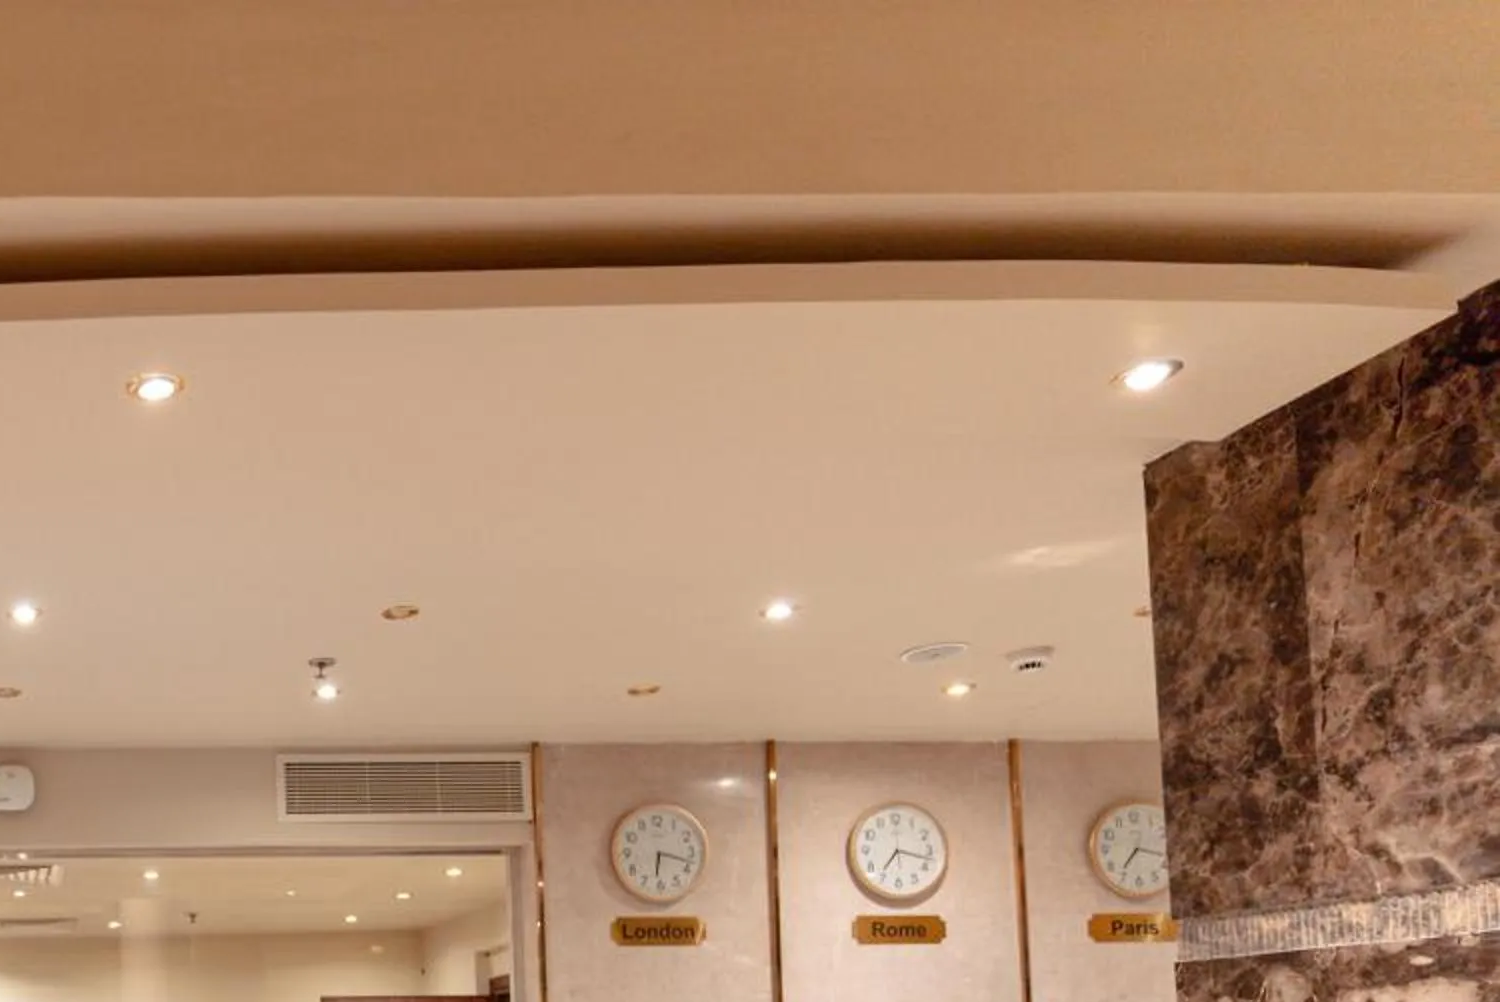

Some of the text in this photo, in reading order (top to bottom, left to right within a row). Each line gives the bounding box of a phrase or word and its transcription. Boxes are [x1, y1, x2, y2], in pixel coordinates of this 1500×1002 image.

[621, 923, 696, 941] London
[871, 920, 928, 938] Rome
[1111, 920, 1160, 937] Paris
